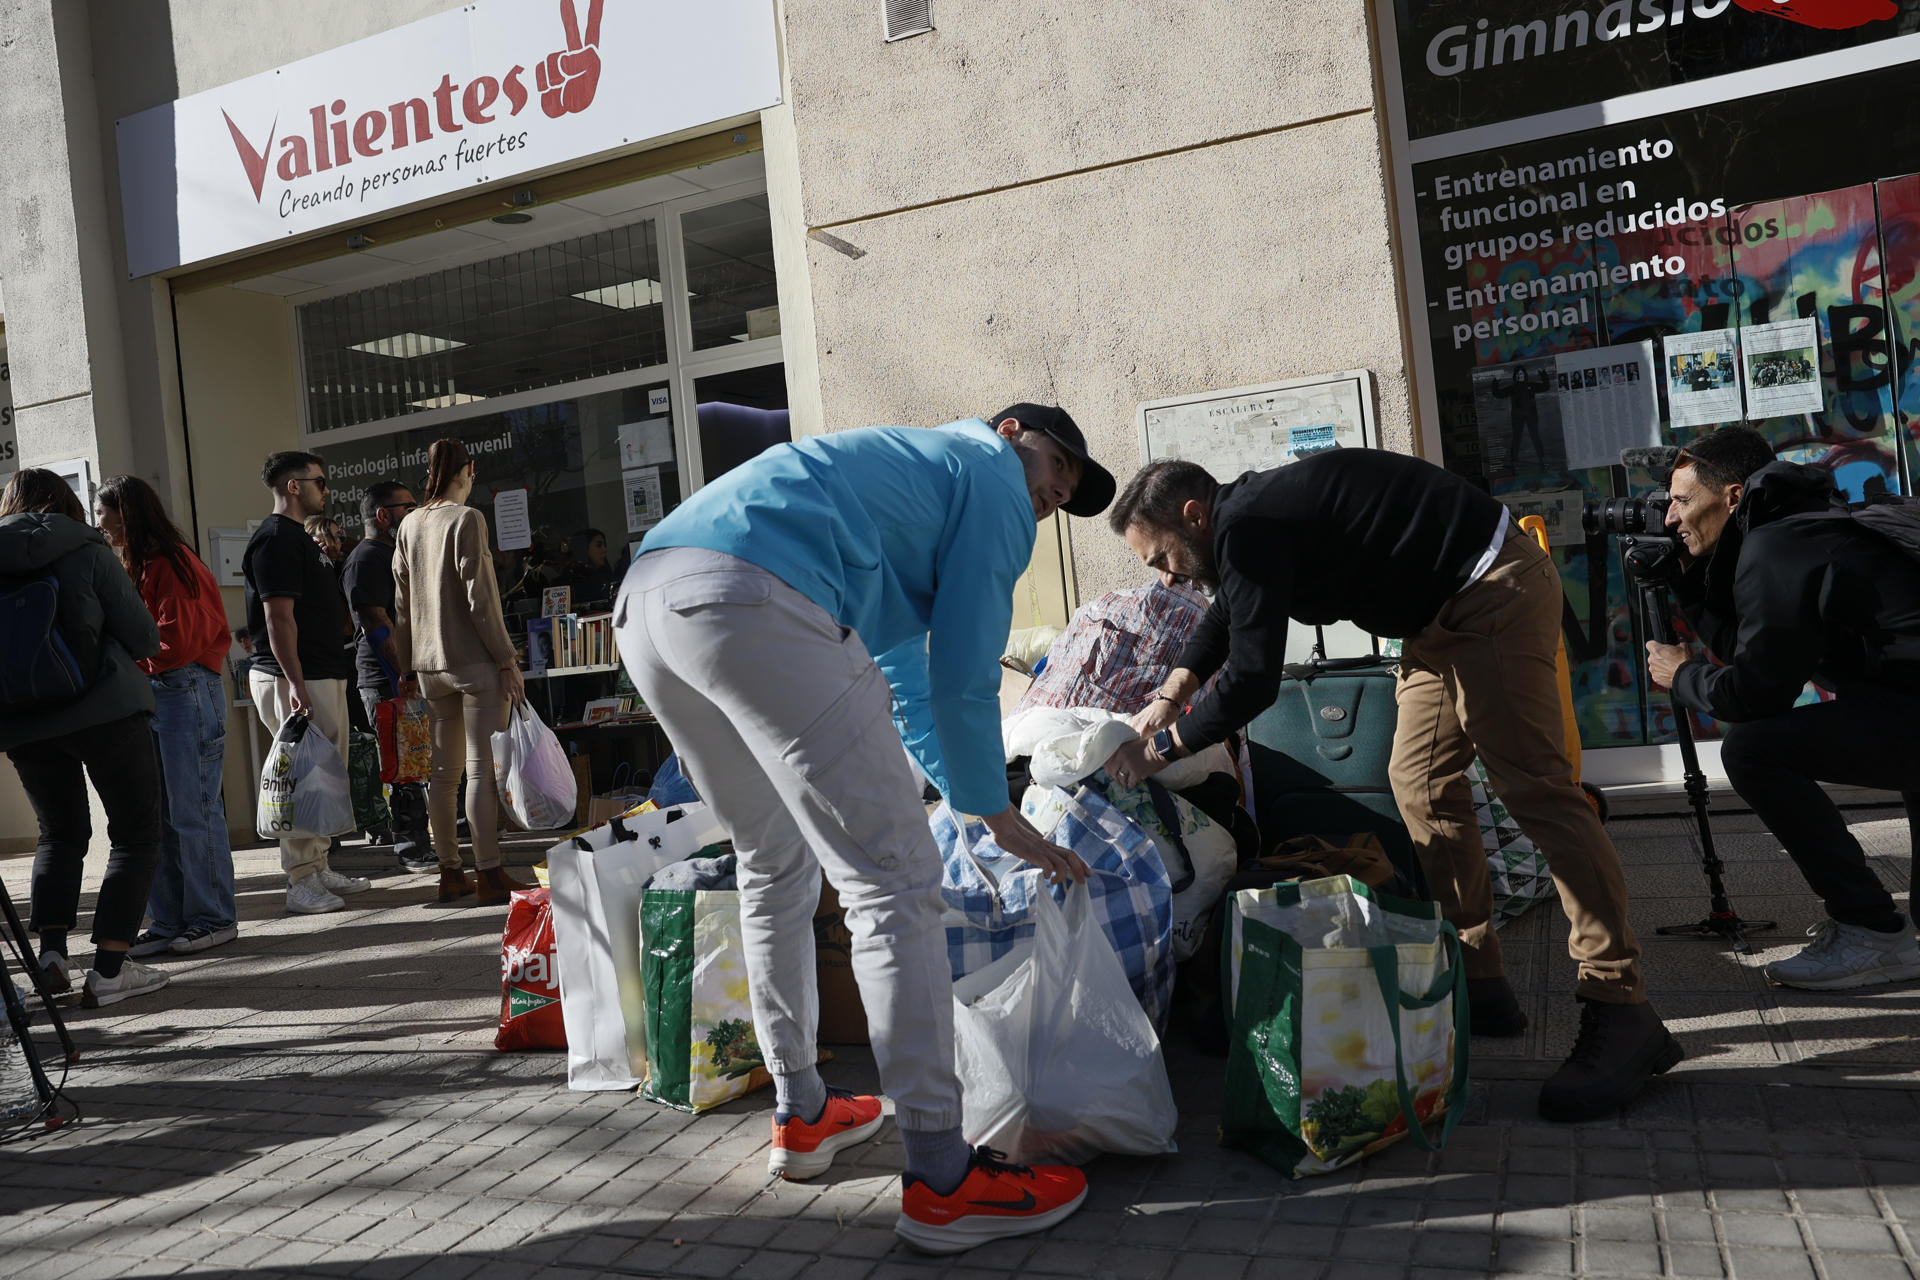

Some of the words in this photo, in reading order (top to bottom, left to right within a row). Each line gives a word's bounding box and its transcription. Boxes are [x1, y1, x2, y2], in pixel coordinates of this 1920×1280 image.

[1425, 0, 1732, 79] Gimnasio
[220, 65, 529, 205] Valientes
[280, 176, 355, 219] Creando
[360, 153, 448, 203] personas
[455, 131, 528, 170] fuertes
[1434, 135, 1674, 202] Entrenamiento
[1440, 180, 1588, 232] funcional
[1596, 179, 1636, 204] en
[1444, 222, 1554, 270] grupos
[1561, 195, 1727, 250] reducidos
[1446, 251, 1686, 312] Entrenamiento
[1453, 298, 1590, 348] personal
[651, 396, 668, 406] VISA
[328, 451, 398, 482] Psicología
[401, 446, 430, 470] infa
[466, 432, 513, 455] uvenil
[333, 511, 363, 529] Clas
[500, 943, 559, 991] ebaj
